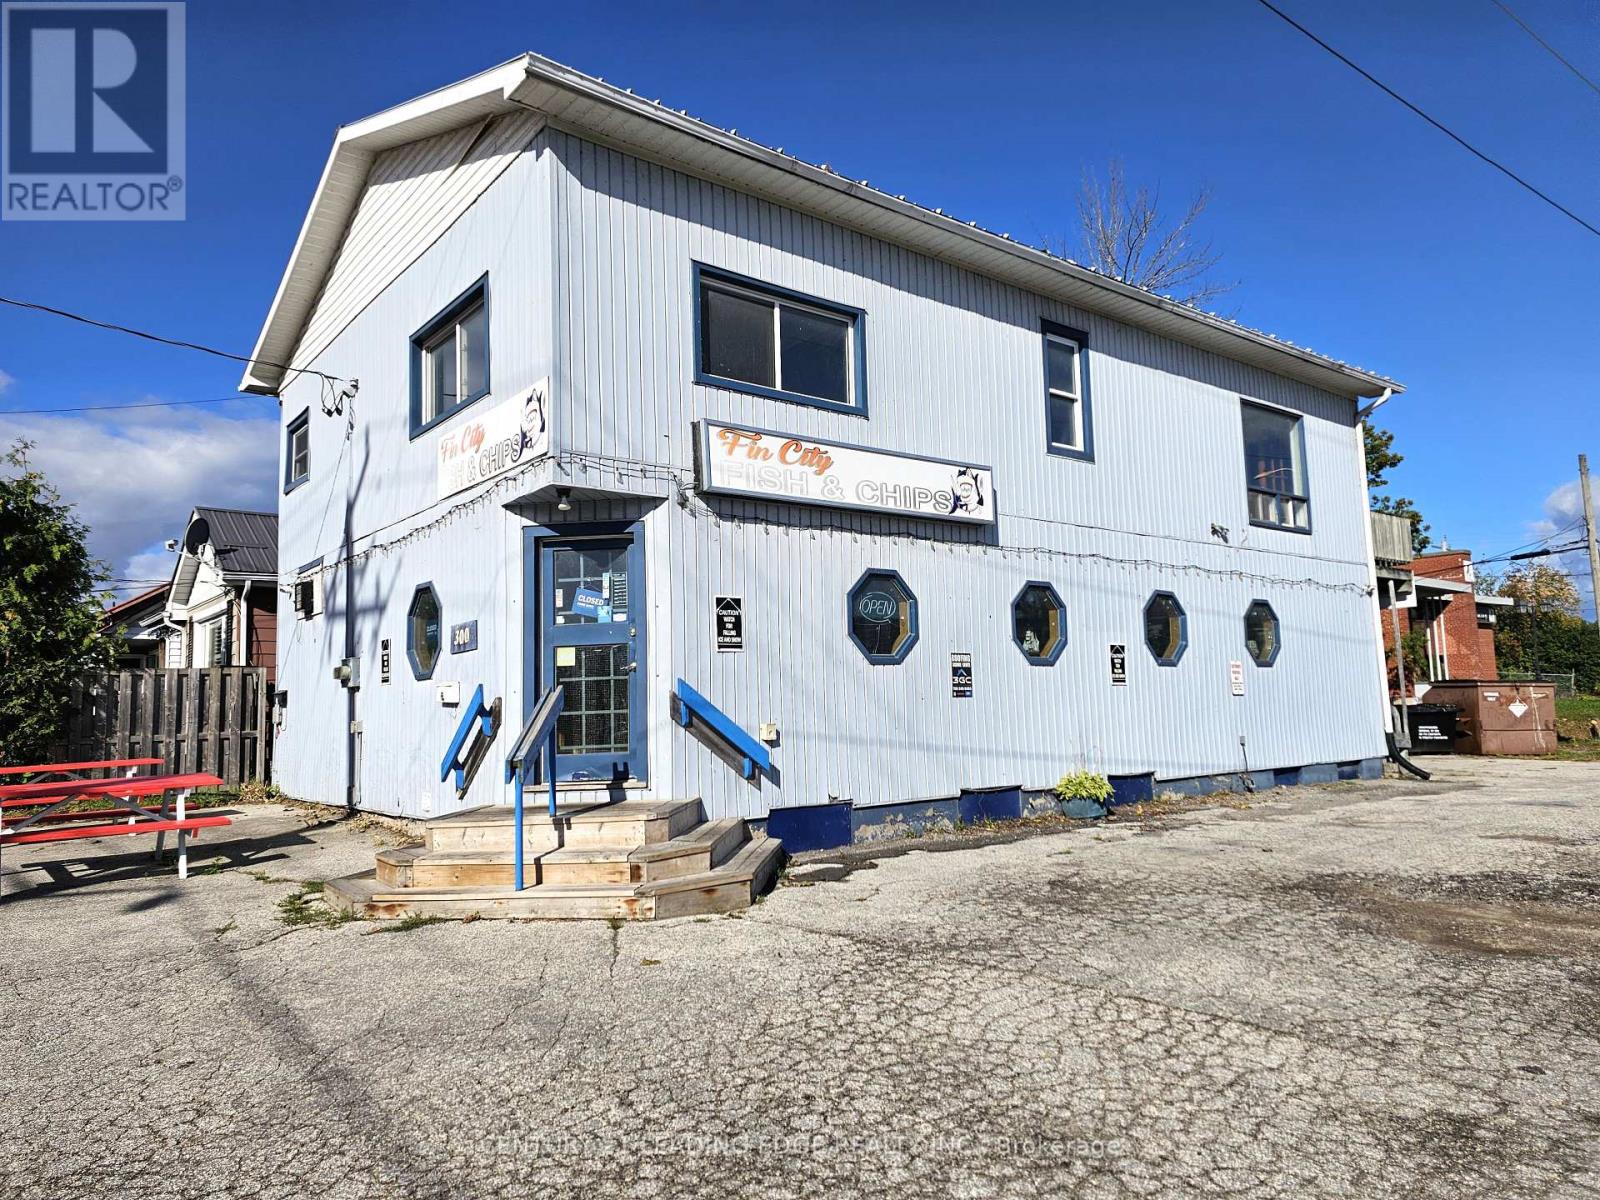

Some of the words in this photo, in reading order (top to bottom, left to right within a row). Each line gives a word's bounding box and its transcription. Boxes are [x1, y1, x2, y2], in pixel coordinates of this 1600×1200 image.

[461, 423, 486, 454] City
[480, 433, 521, 477] CHIPS
[719, 428, 773, 461] Fin
[779, 440, 834, 475] City
[719, 459, 809, 496] FISH
[821, 474, 846, 501] &
[855, 479, 953, 513] CHIPS
[577, 594, 604, 606] CLOSED
[862, 599, 893, 615] OPEN
